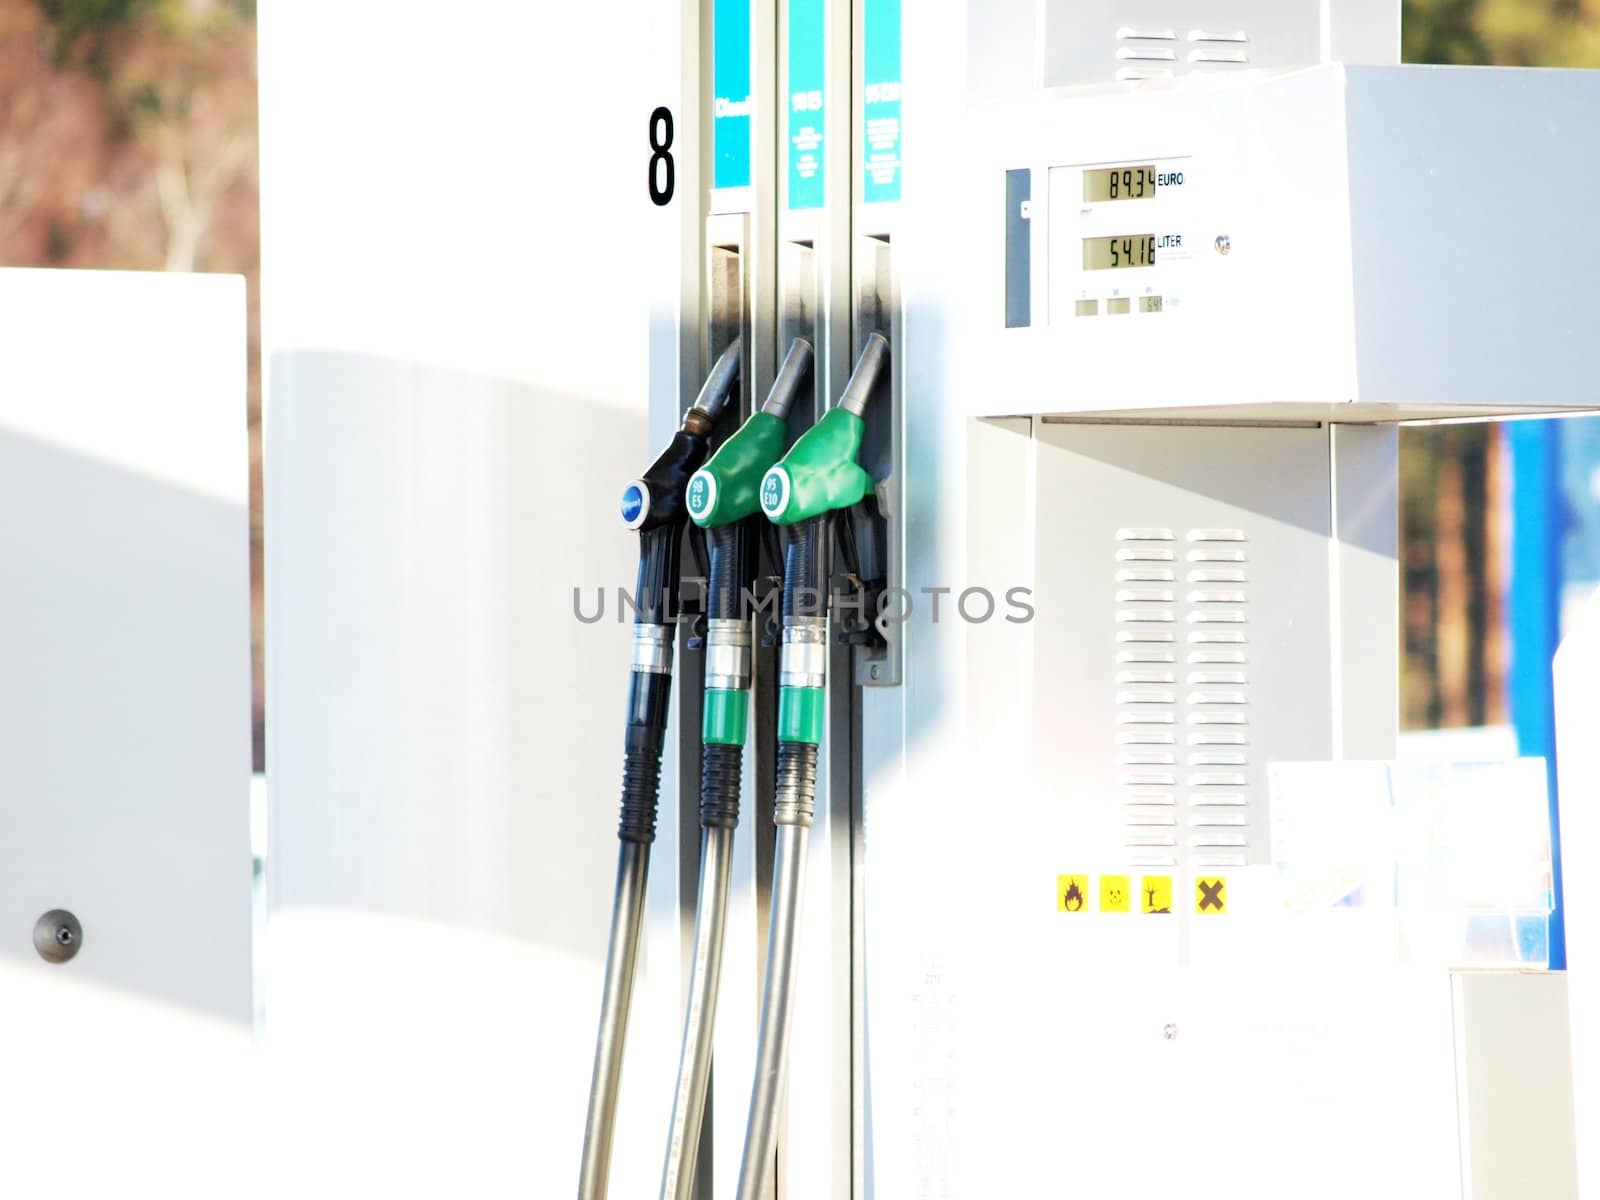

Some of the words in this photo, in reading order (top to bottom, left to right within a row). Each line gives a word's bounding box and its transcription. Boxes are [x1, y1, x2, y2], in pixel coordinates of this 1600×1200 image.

[649, 106, 675, 206] 8
[1157, 173, 1184, 187] EURO
[1157, 235, 1182, 249] LITER
[766, 478, 777, 491] 95
